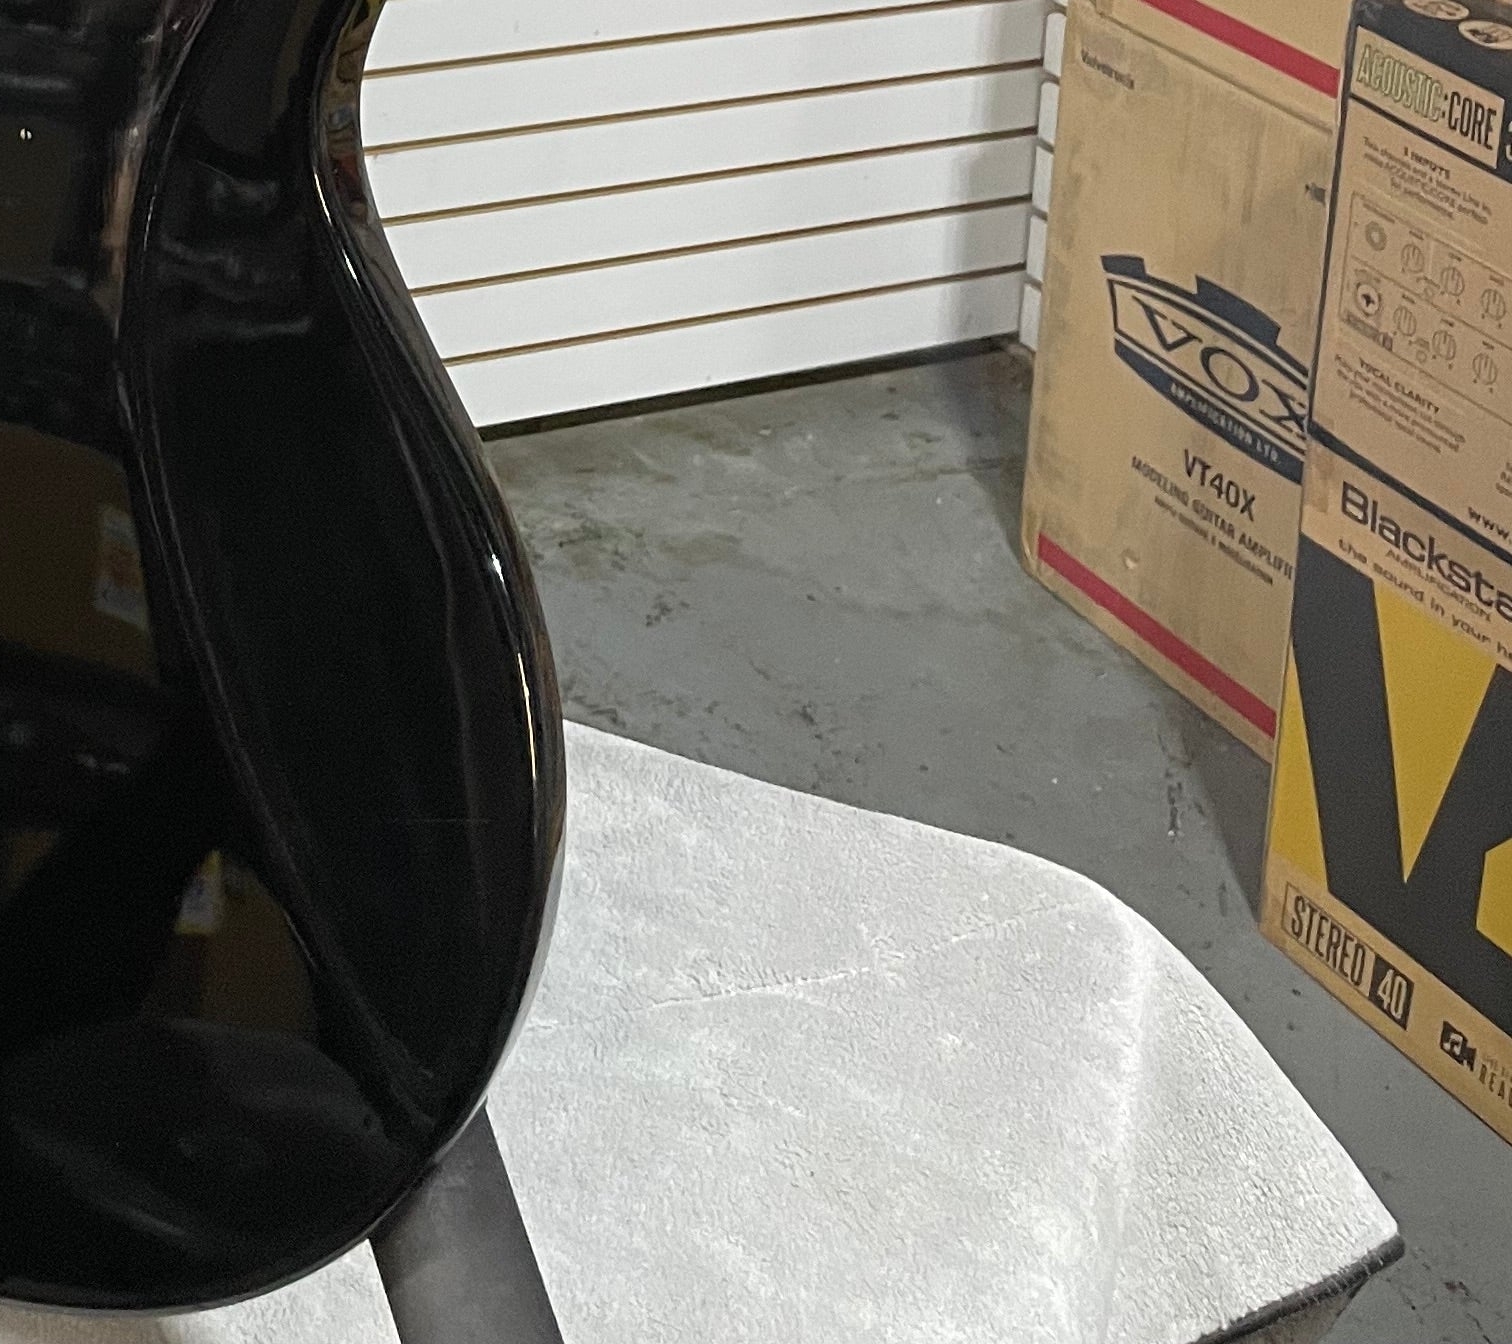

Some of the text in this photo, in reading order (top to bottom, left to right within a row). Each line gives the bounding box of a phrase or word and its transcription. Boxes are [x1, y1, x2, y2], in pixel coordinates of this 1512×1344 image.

[1132, 295, 1308, 441] VOX
[1185, 449, 1257, 522] VT40X
[1338, 538, 1368, 565] the
[1372, 562, 1425, 602] sound
[1430, 597, 1445, 617] in
[1451, 614, 1491, 643] your
[1385, 548, 1491, 623] AMPLIFICATION
[1291, 895, 1408, 1020] STEREO 40
